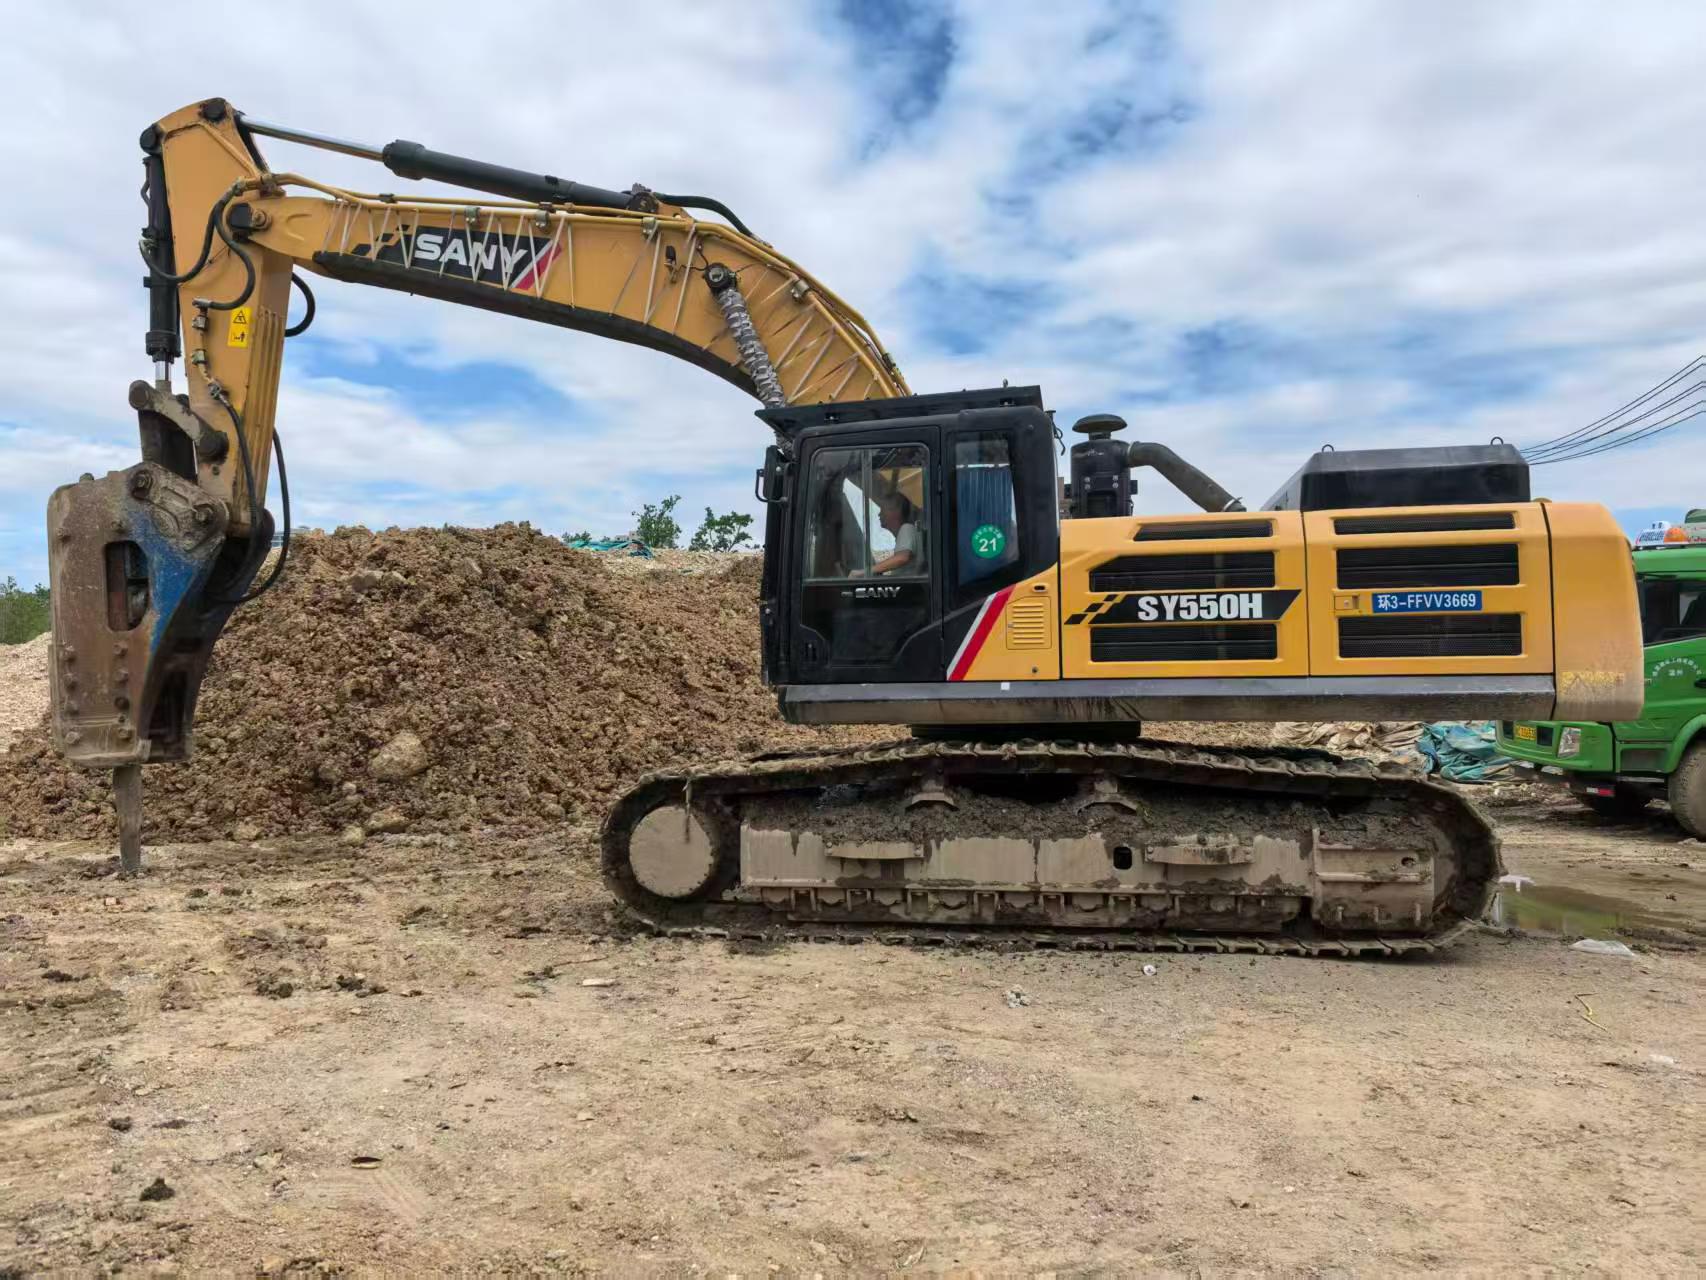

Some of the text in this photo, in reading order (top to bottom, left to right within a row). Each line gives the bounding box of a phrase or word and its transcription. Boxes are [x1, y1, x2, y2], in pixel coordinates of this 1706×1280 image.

[414, 233, 528, 274] SANY
[979, 537, 997, 552] 21
[855, 586, 901, 598] SANY
[1137, 593, 1263, 621] SY550H
